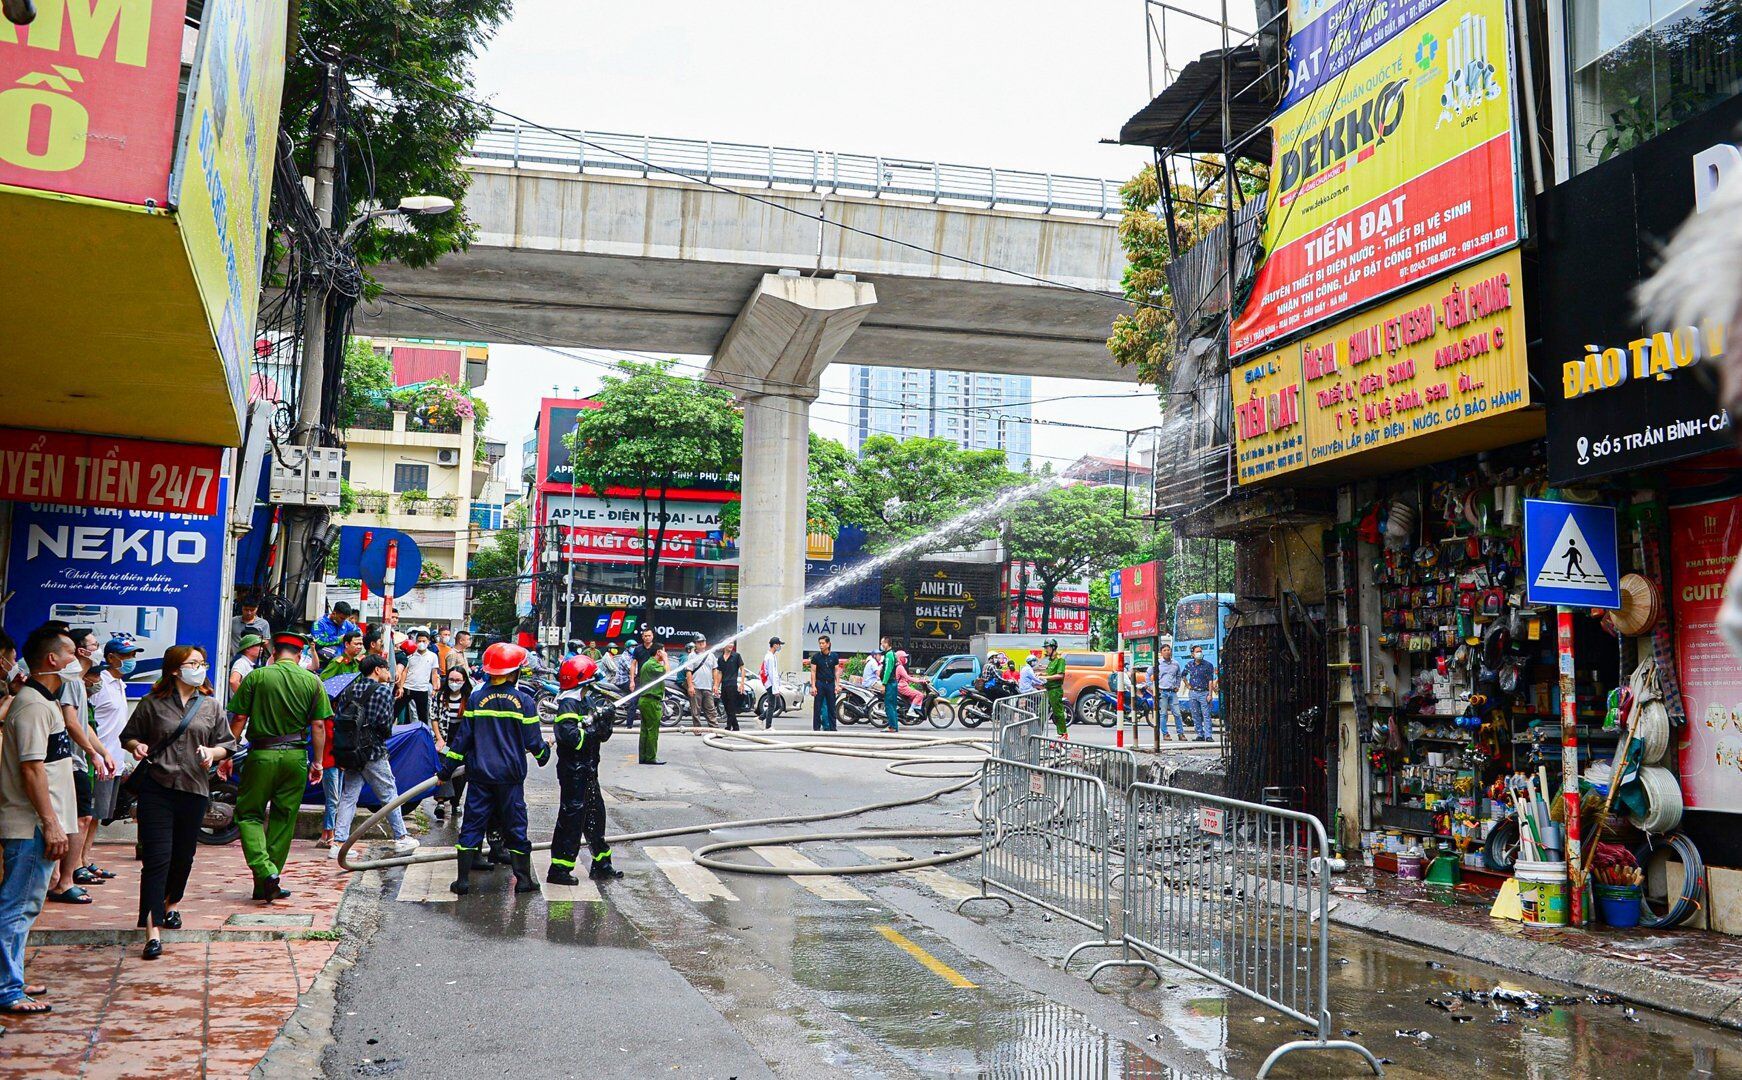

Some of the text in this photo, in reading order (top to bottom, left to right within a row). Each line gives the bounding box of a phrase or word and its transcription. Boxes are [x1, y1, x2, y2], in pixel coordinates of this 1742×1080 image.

[1280, 79, 1405, 193] DEKKO
[1305, 194, 1407, 267] TIẾN ĐẠT
[1461, 226, 1508, 252] 0913.591.031
[1292, 271, 1314, 292] THIẾT
[1316, 268, 1325, 282] BỊ
[1326, 259, 1347, 277] ĐIỆN
[1349, 244, 1375, 265] NƯỚC
[1384, 226, 1411, 250] THIẾT
[1414, 221, 1425, 236] BỊ
[1427, 212, 1441, 230] VỆ
[1444, 200, 1472, 223] SINH
[1300, 291, 1314, 305] THI
[1343, 266, 1360, 286] LẮP
[1363, 258, 1382, 279] ĐẶT
[1384, 246, 1412, 269] CÔNG
[1415, 231, 1447, 255] TRÌNH
[1469, 272, 1512, 321] PHONG
[1303, 306, 1314, 319] CẦU
[1563, 325, 1701, 400] ĐÀO TẠO
[1359, 373, 1384, 396] điện
[1387, 358, 1416, 386] SINO
[1425, 382, 1449, 403] sen
[1236, 387, 1269, 442] TIẾN
[1311, 439, 1343, 459] CHUYÊN
[1346, 432, 1361, 449] LẮP
[1365, 429, 1380, 446] ĐẶT
[1383, 421, 1405, 439] ĐIỆN
[1446, 402, 1461, 422] CÓ
[1464, 396, 1487, 417] BẢO
[1491, 388, 1522, 409] HÀNH
[1593, 434, 1611, 457] SỐ
[1613, 437, 1621, 453] 5
[1623, 426, 1663, 450] TRẦN
[75, 445, 140, 504] TIỀN
[147, 463, 214, 510] 24/7
[554, 465, 574, 474] APP
[700, 472, 717, 484] PHỤ
[552, 508, 596, 520] APPLE
[607, 509, 640, 524] ĐIỆN
[696, 516, 720, 525] LAP
[27, 524, 207, 566] NEKIO
[592, 531, 624, 549] KẾT
[90, 571, 109, 582] liệu
[120, 571, 143, 582] thiên
[146, 573, 171, 582] nhiên
[40, 579, 67, 590] chăm
[69, 580, 82, 591] sóc
[119, 585, 138, 596] gia
[140, 582, 161, 593] đình
[920, 581, 962, 596] ANH TÚ
[1682, 583, 1730, 602] GUITA
[578, 590, 602, 605] TÂM
[605, 595, 646, 607] LAPTOP
[655, 597, 682, 607] CAM
[686, 593, 703, 609] KẾT
[915, 604, 964, 617] BAKERY
[807, 616, 866, 635] MẮT LILY
[1063, 622, 1072, 631] XE
[1074, 620, 1084, 631] SỐ
[1204, 818, 1218, 829] STOP
